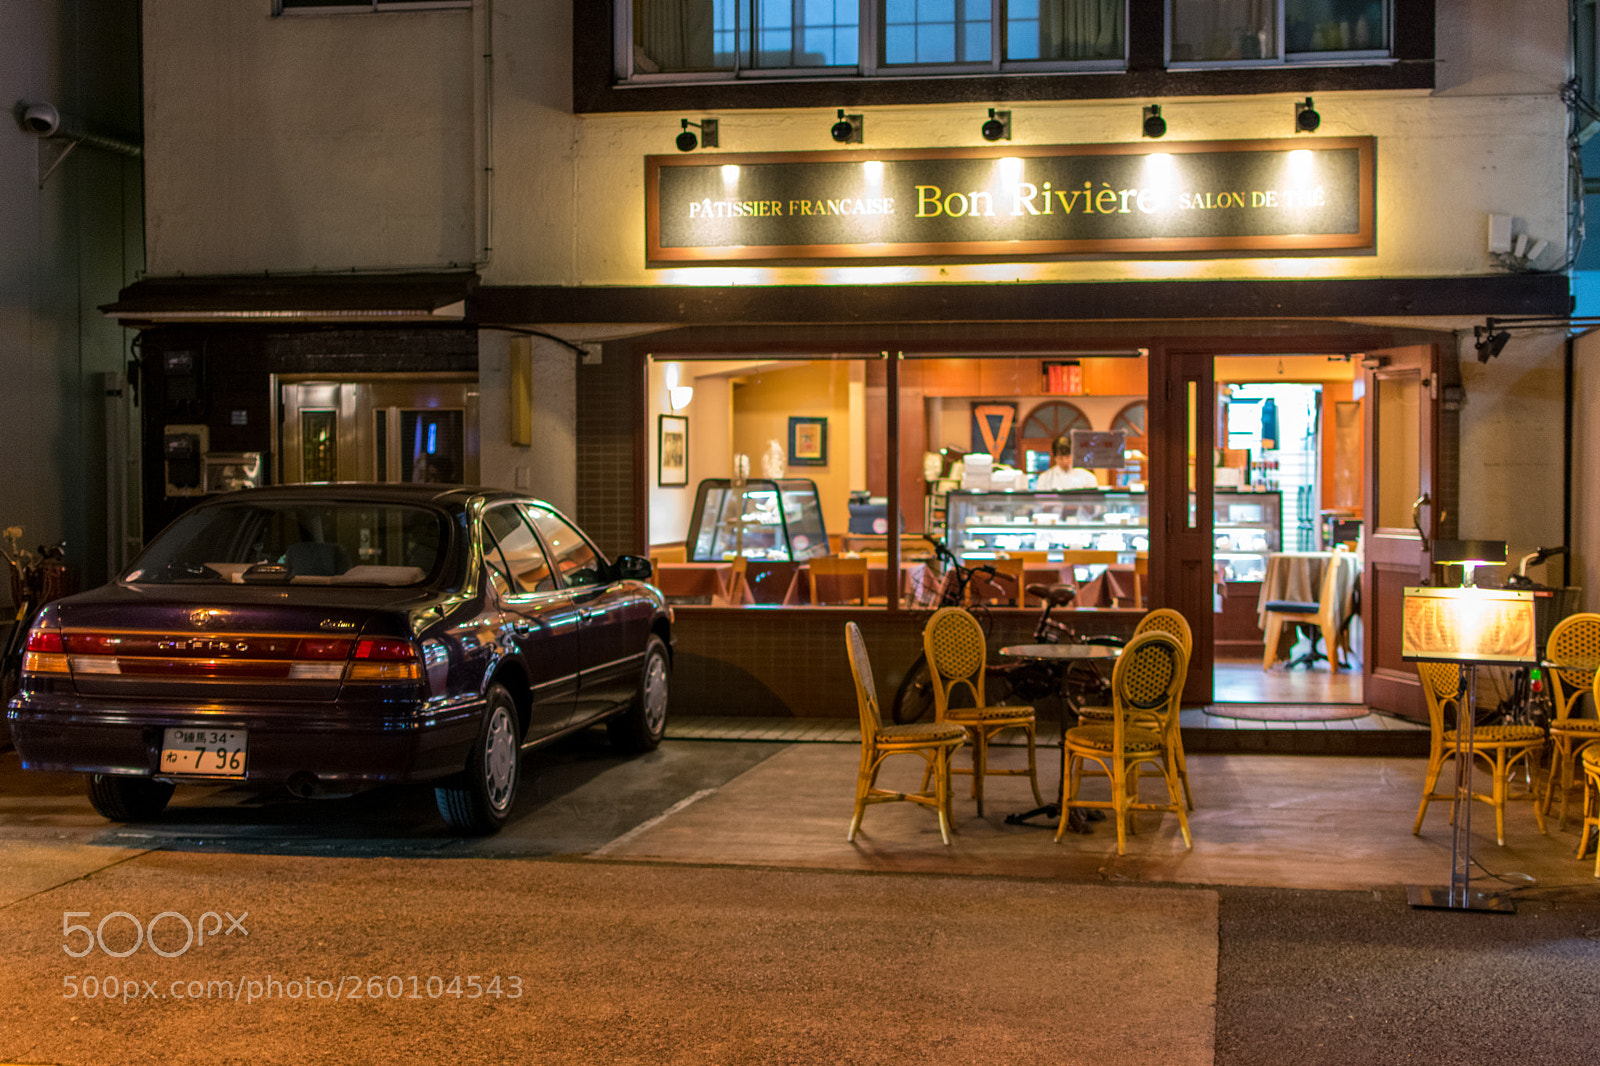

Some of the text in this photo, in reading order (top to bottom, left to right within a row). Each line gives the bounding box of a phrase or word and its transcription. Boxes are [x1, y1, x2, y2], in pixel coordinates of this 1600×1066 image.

[689, 198, 783, 218] PÂTISSIER
[915, 185, 996, 218] Bon
[1009, 180, 1161, 216] Rivière
[1179, 191, 1246, 209] SALON
[1251, 190, 1279, 208] DE
[209, 732, 227, 744] 34
